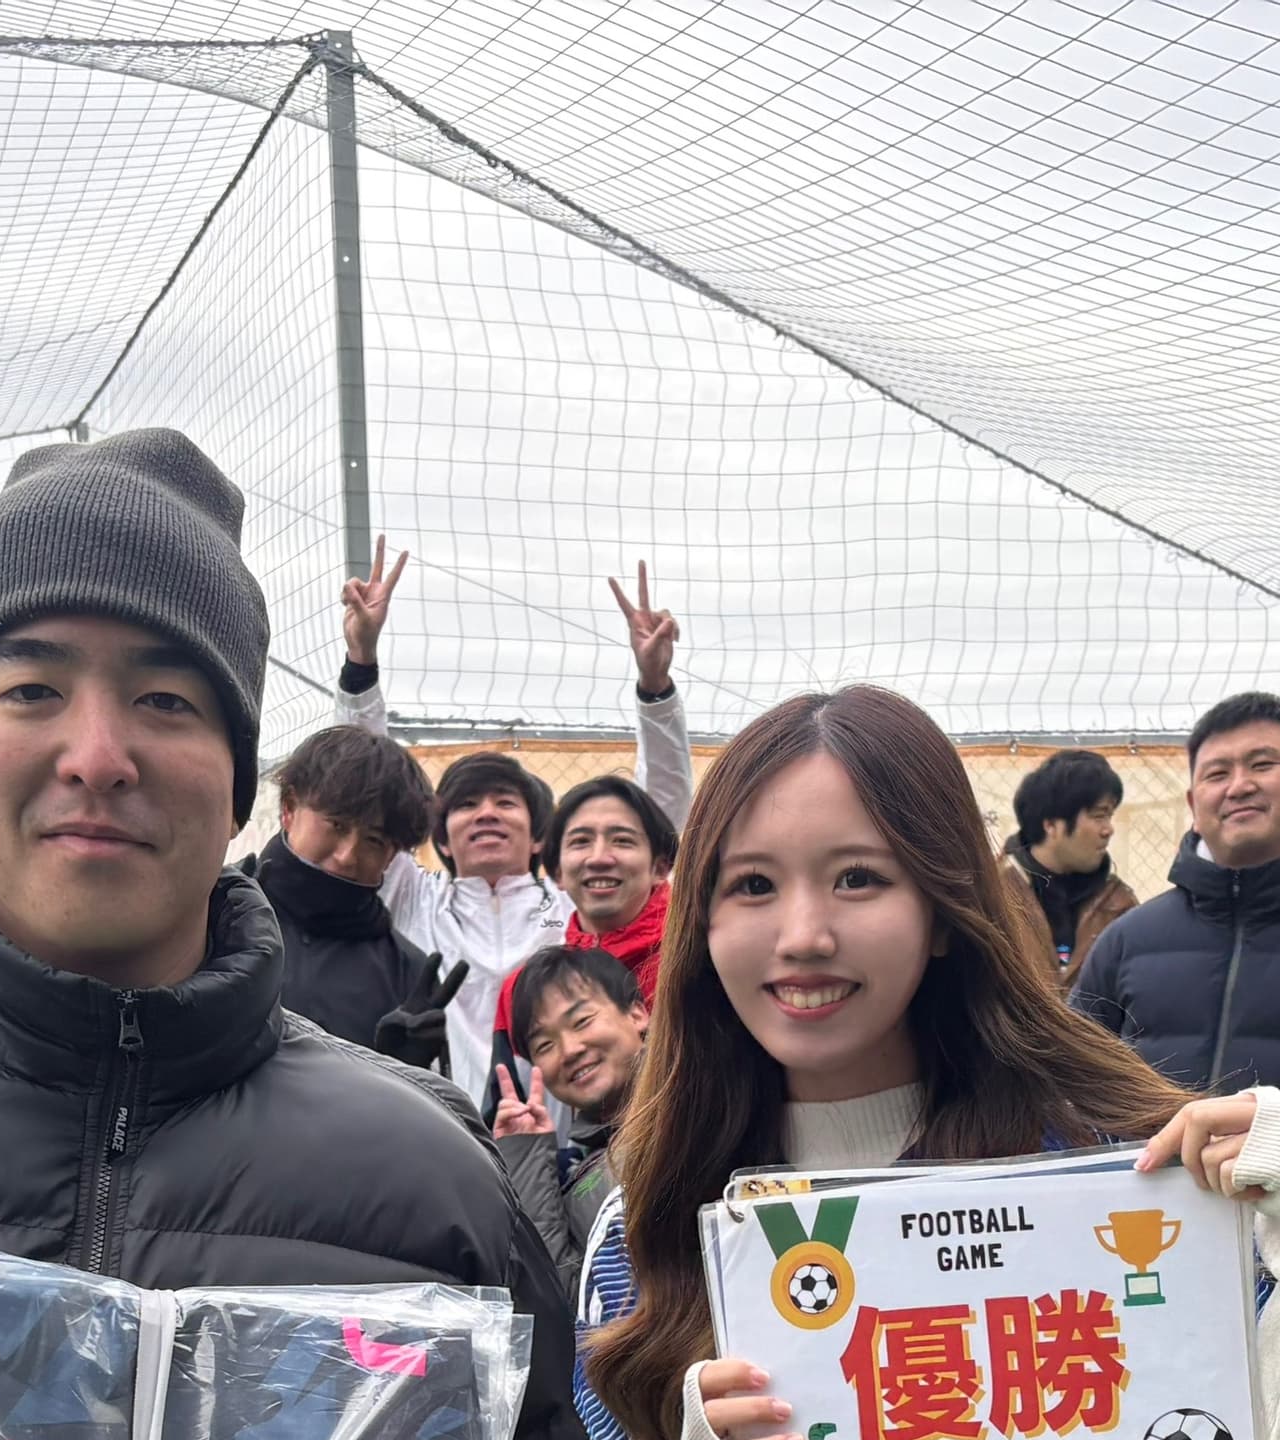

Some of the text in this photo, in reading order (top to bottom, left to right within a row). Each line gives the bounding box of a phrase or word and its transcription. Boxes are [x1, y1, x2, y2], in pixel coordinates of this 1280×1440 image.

[111, 1106, 128, 1152] PALACE
[900, 1205, 1035, 1239] FOOTBALL
[936, 1243, 1005, 1272] GAME
